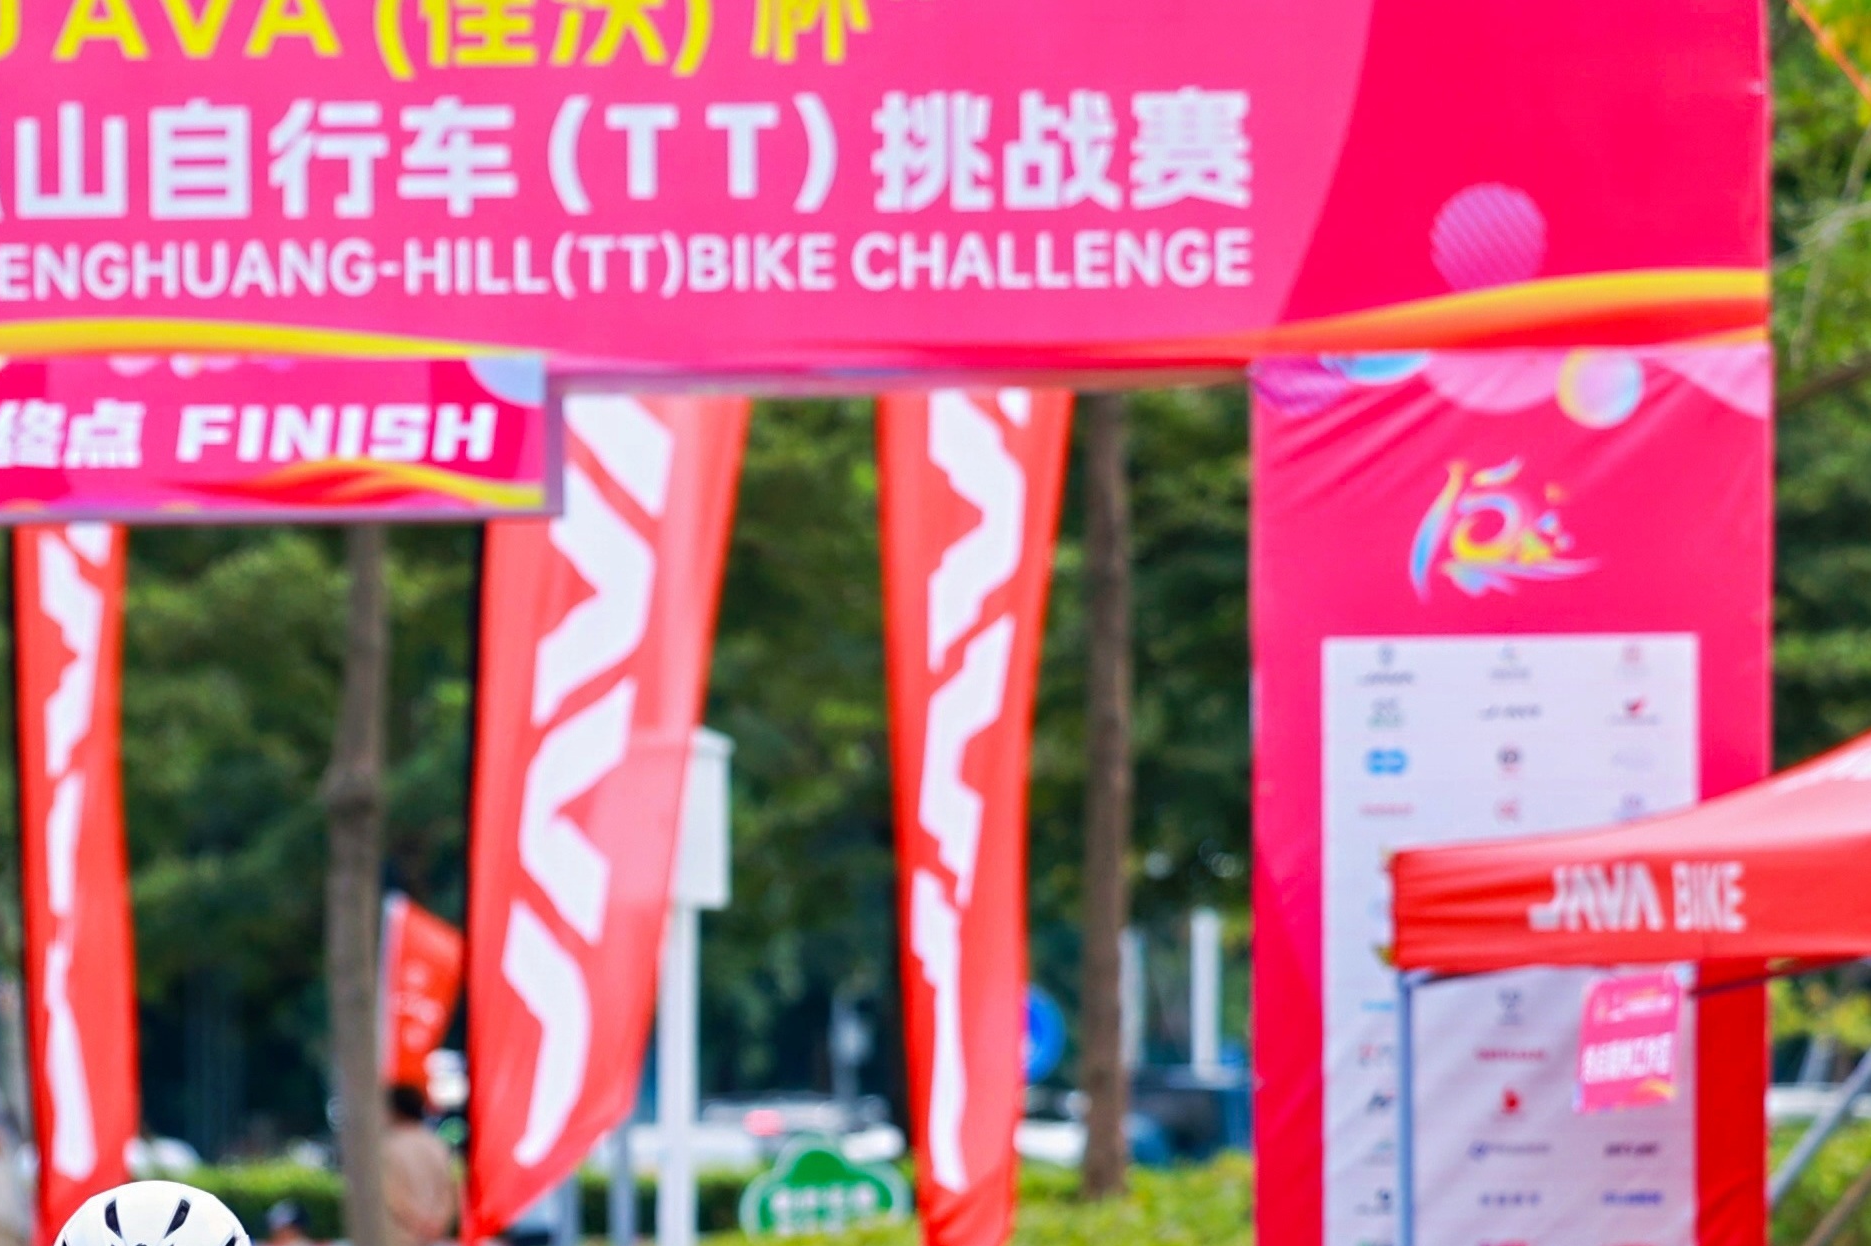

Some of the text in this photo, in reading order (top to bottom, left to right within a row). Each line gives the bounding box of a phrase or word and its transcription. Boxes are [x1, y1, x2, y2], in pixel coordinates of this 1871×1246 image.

[850, 226, 1252, 291] CHALLENGE
[175, 403, 498, 462] FINISH
[1527, 861, 1746, 932] JAVA BIKE
